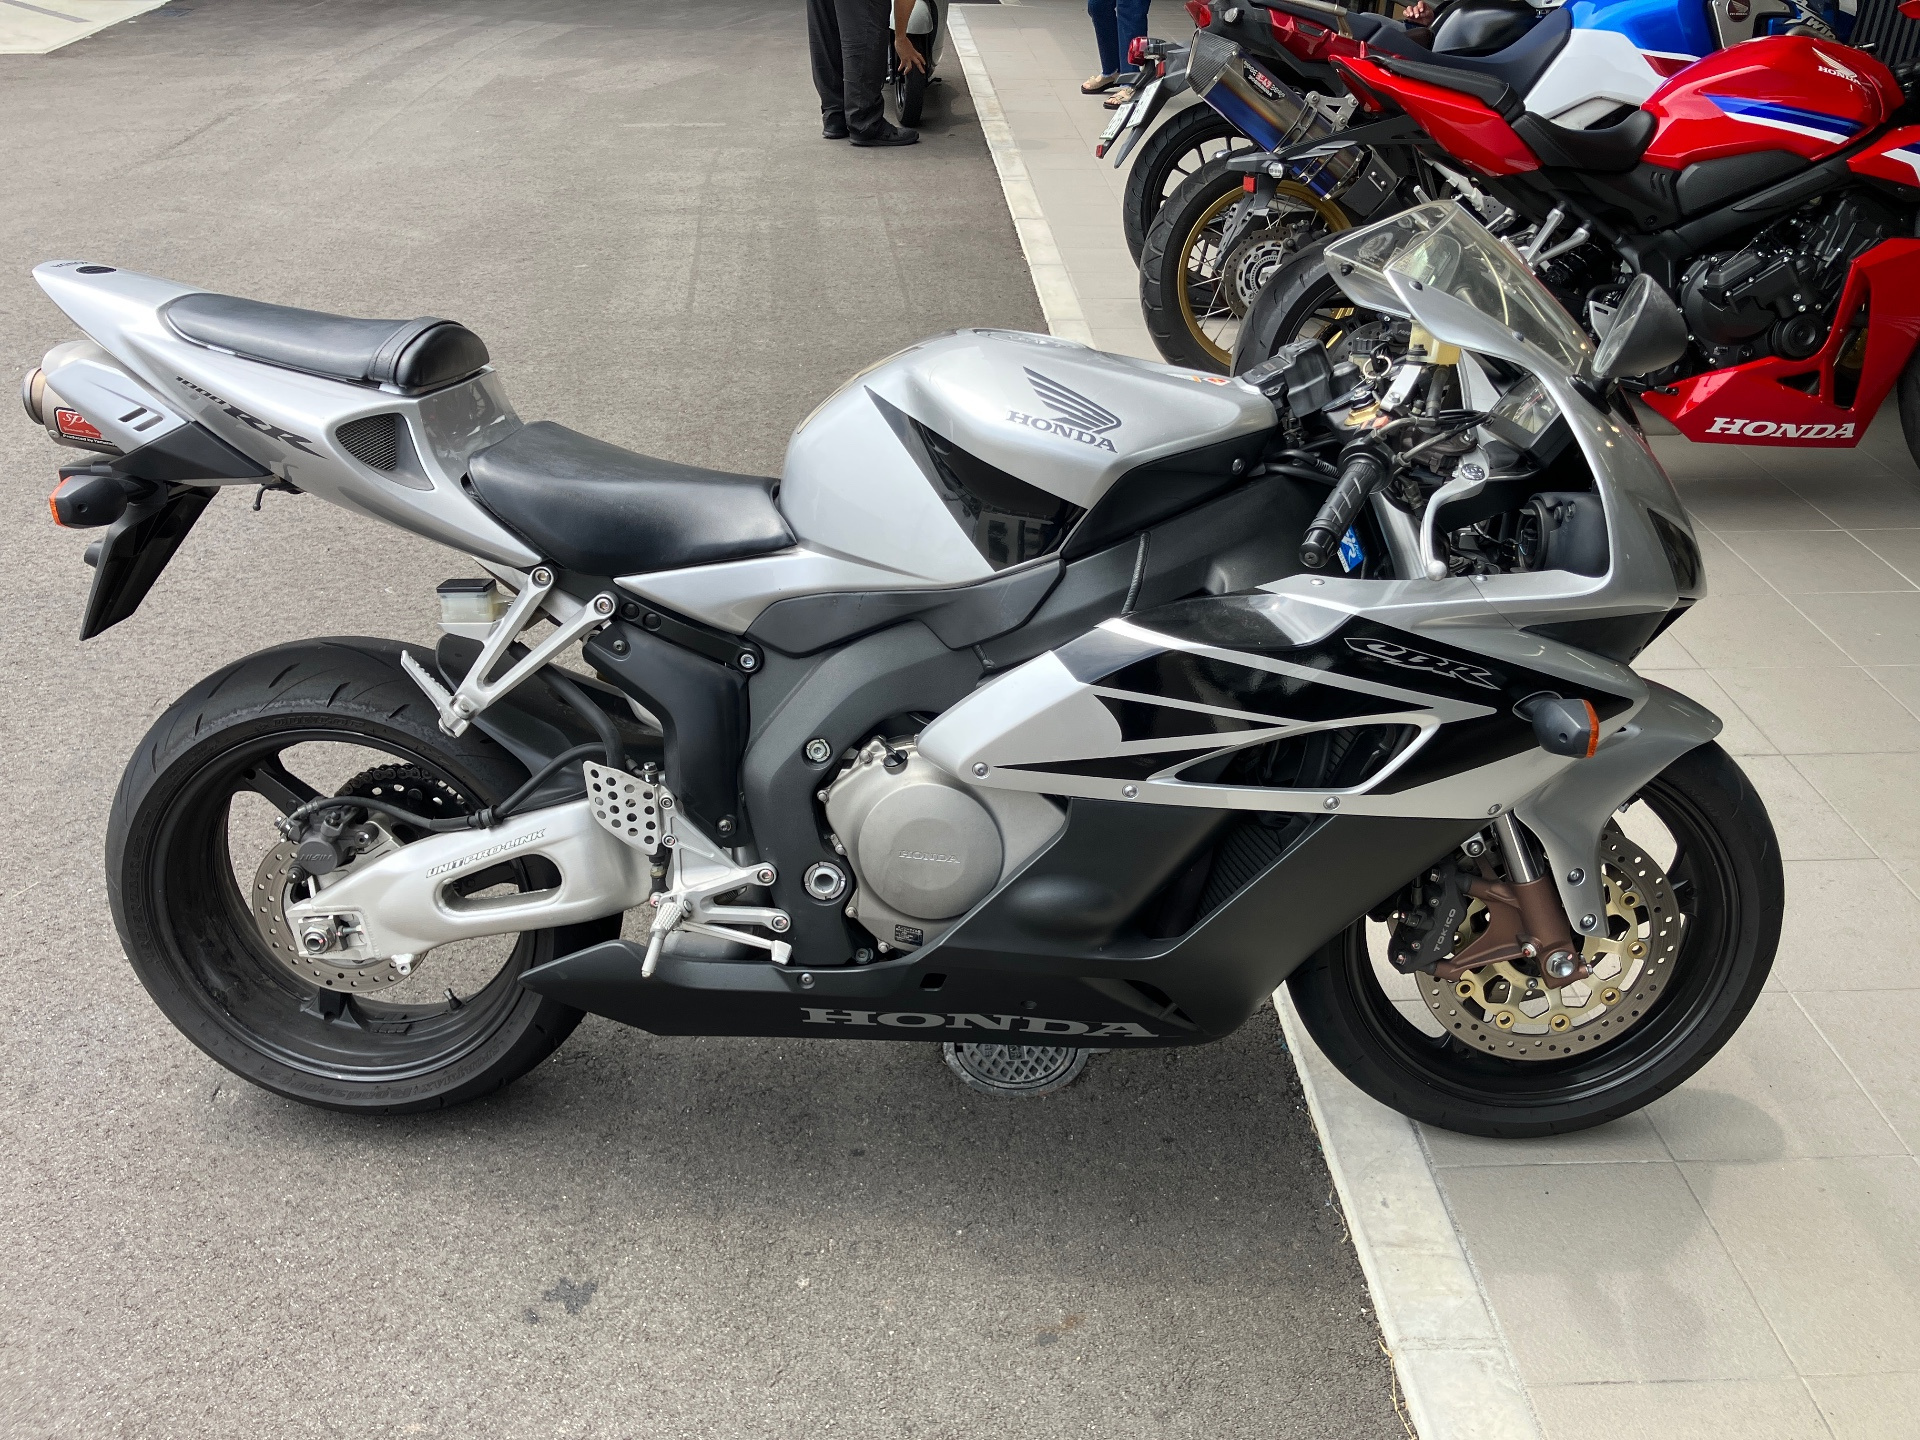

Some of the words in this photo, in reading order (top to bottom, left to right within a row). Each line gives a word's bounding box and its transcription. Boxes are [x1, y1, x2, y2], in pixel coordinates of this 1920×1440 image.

[1818, 65, 1862, 86] HONDA
[1005, 409, 1118, 454] HONDA
[1705, 417, 1856, 439] HONDA
[1343, 637, 1502, 691] CBR
[426, 857, 465, 878] UNIT
[464, 828, 547, 866] PRO-LINK
[898, 850, 961, 864] HONDA
[1433, 908, 1456, 952] TOKICO
[800, 1007, 1160, 1038] HONDA
